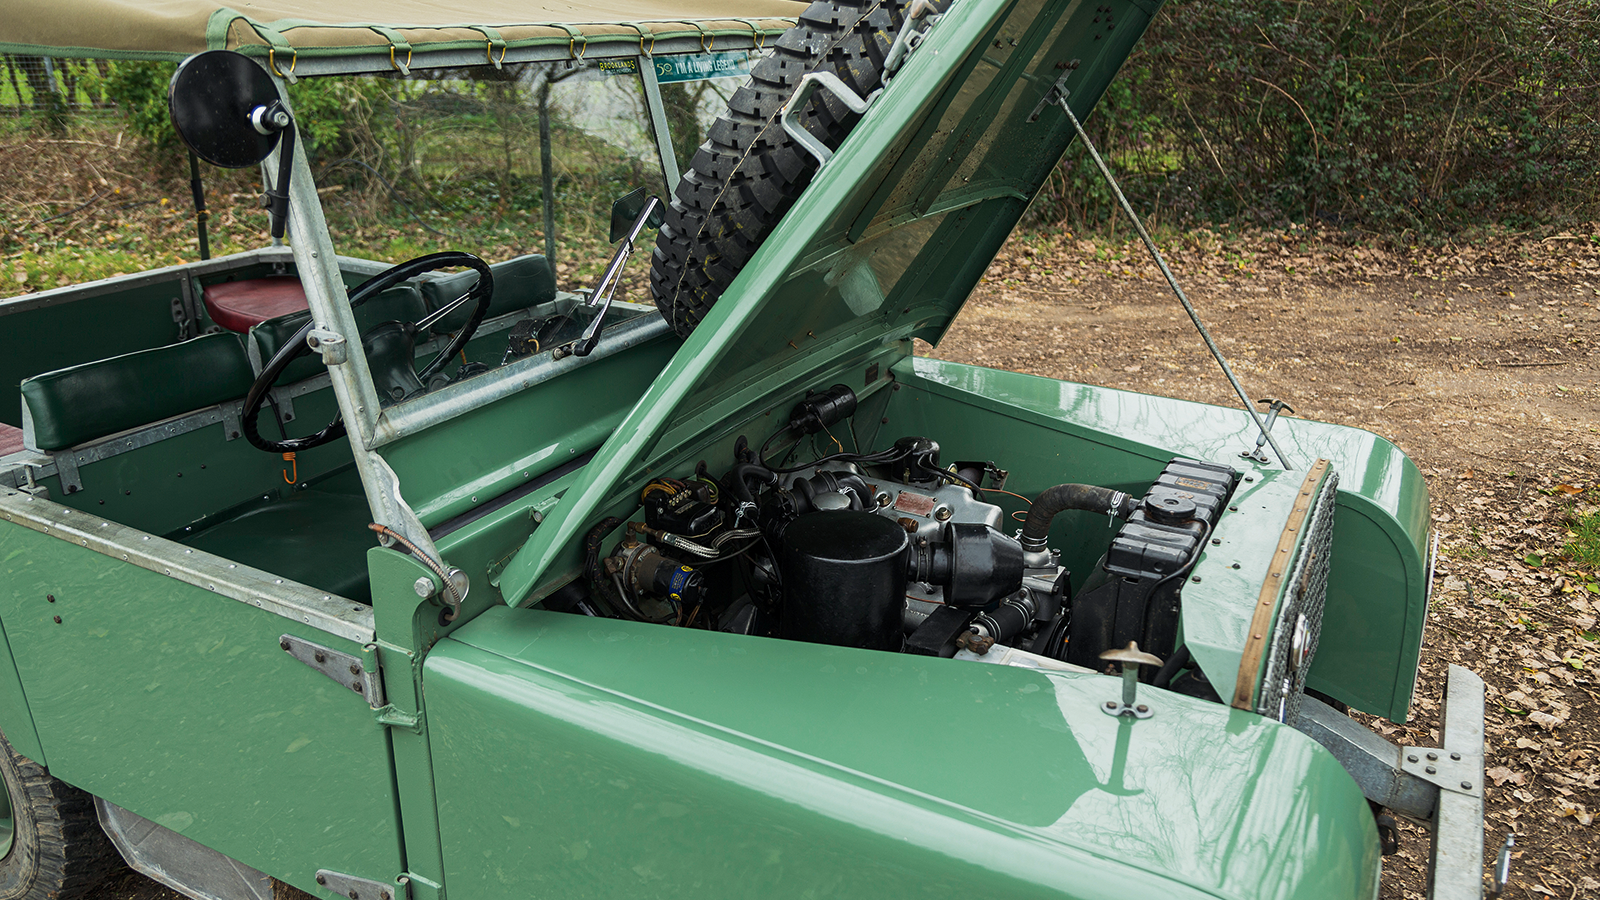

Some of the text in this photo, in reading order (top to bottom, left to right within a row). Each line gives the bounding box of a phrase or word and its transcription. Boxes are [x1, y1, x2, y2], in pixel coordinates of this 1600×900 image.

[599, 60, 635, 72] BROOKLANDS
[675, 59, 736, 75] I'M A LIVING LEGEND
